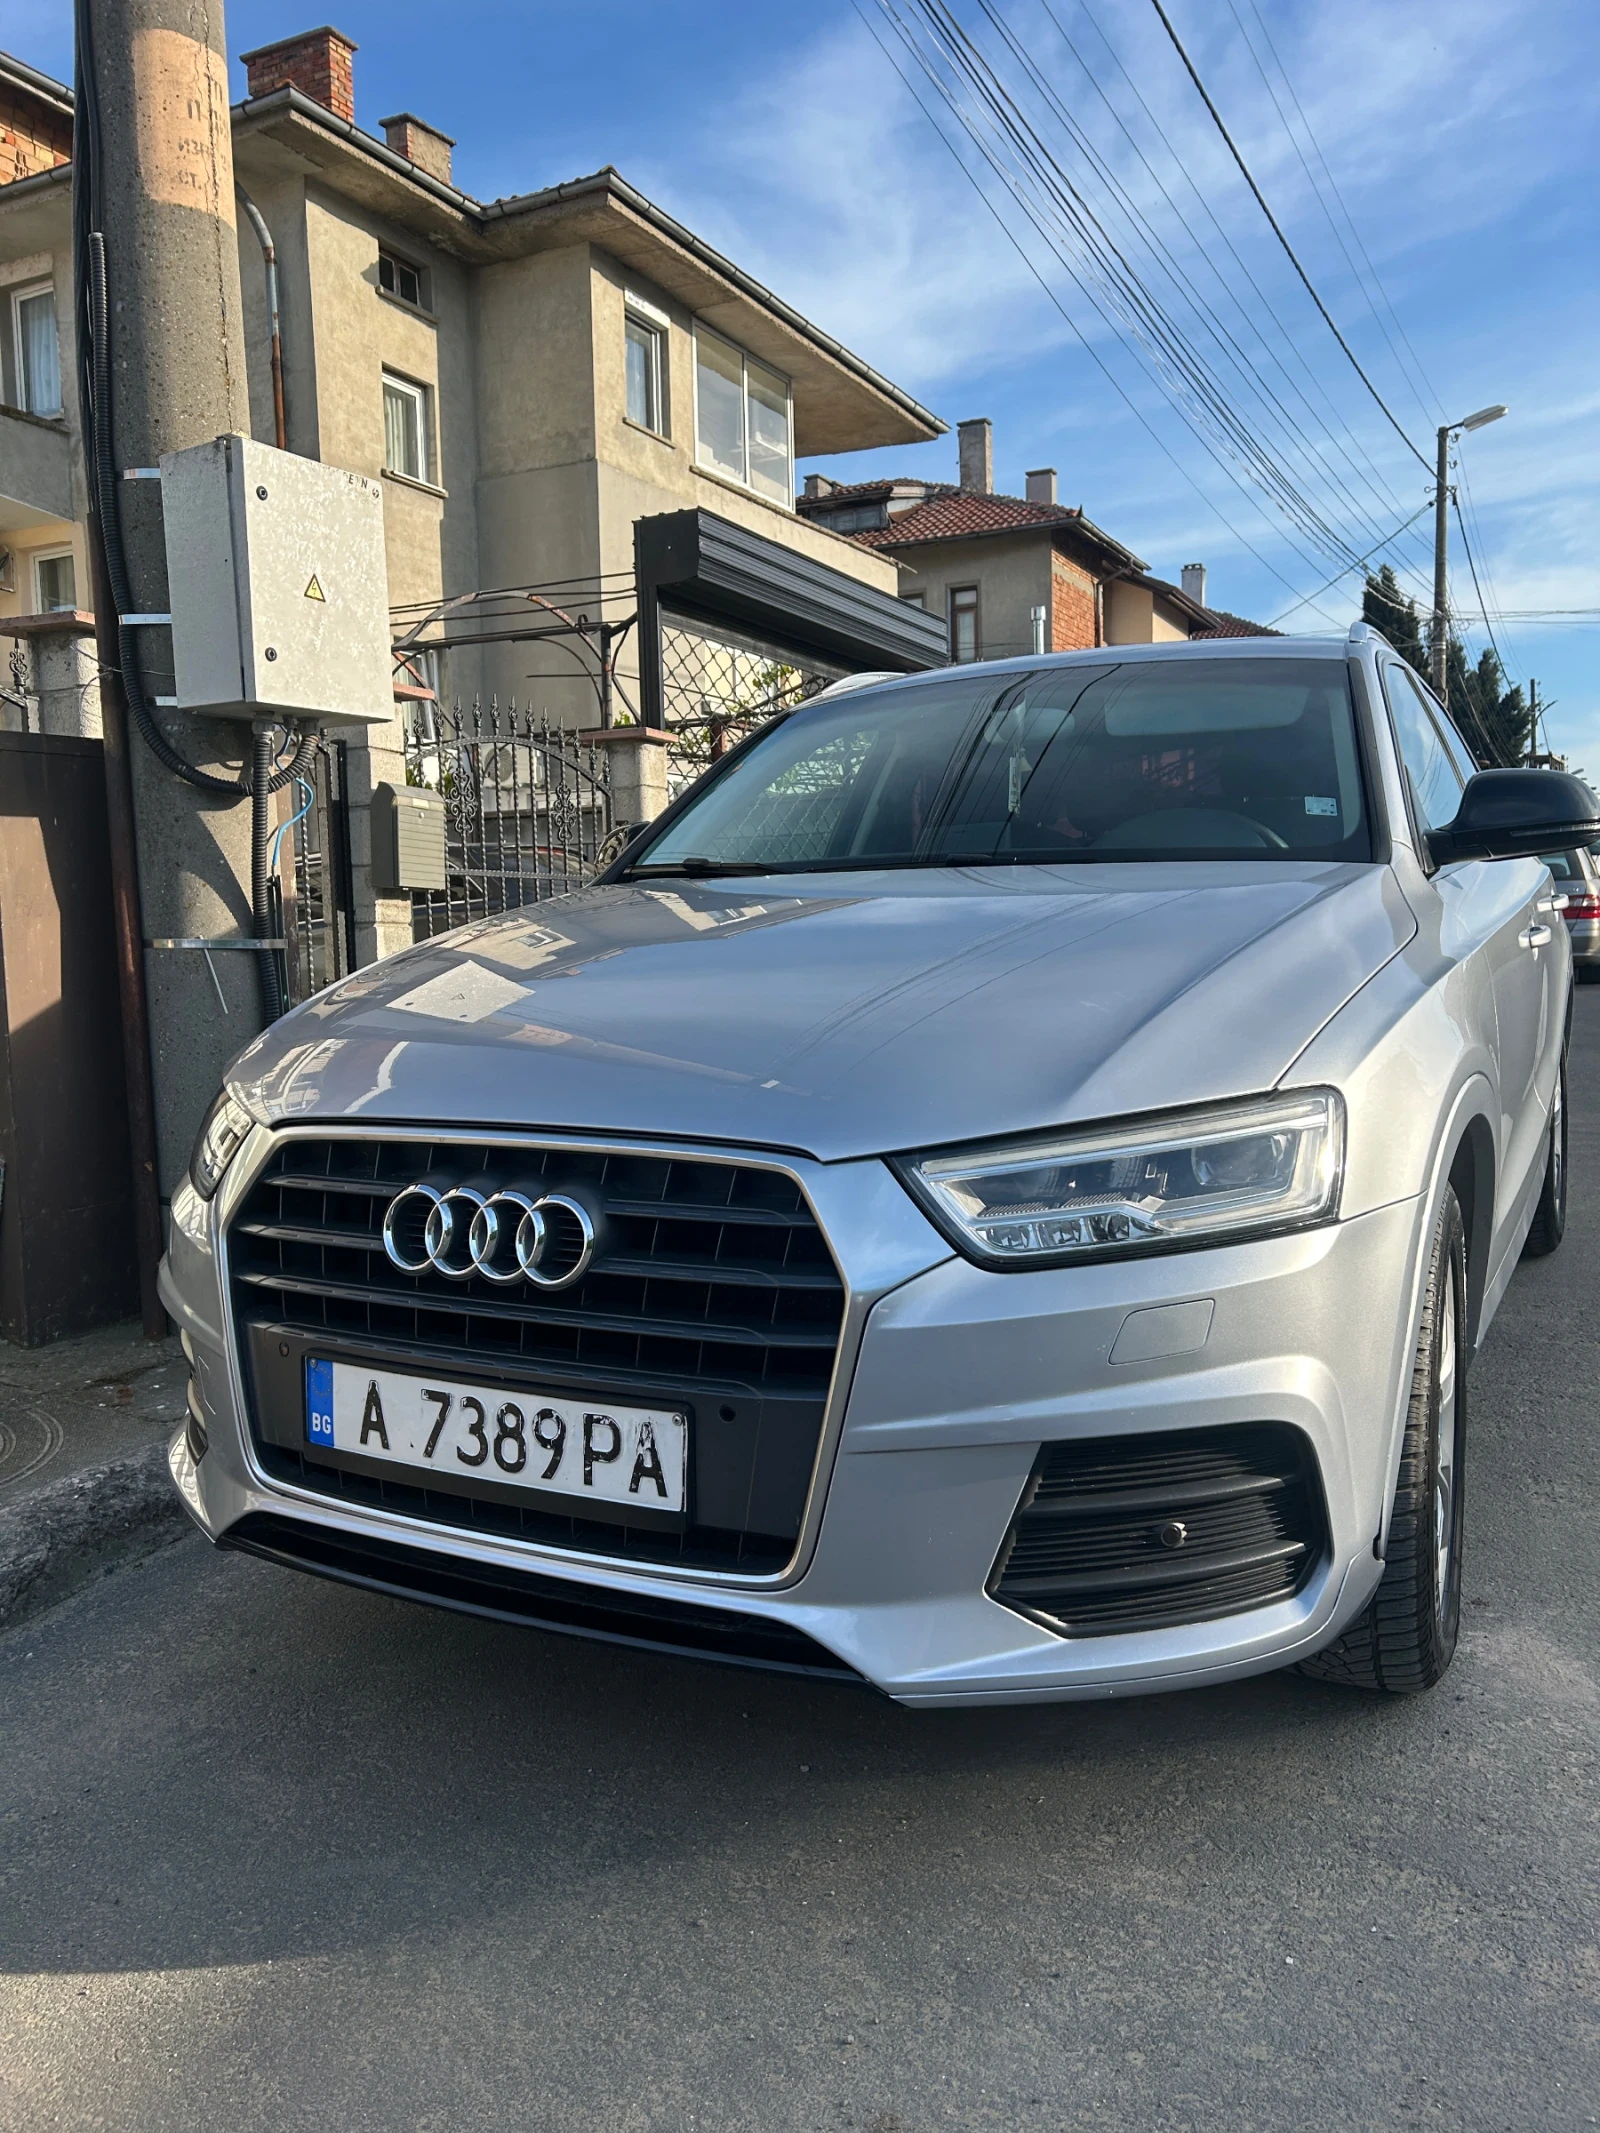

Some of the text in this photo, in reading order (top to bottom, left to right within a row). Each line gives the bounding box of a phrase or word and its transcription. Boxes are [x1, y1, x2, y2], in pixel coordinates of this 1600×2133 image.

[311, 1411, 332, 1435] BG
[359, 1379, 391, 1450] A
[420, 1387, 568, 1480] 7389
